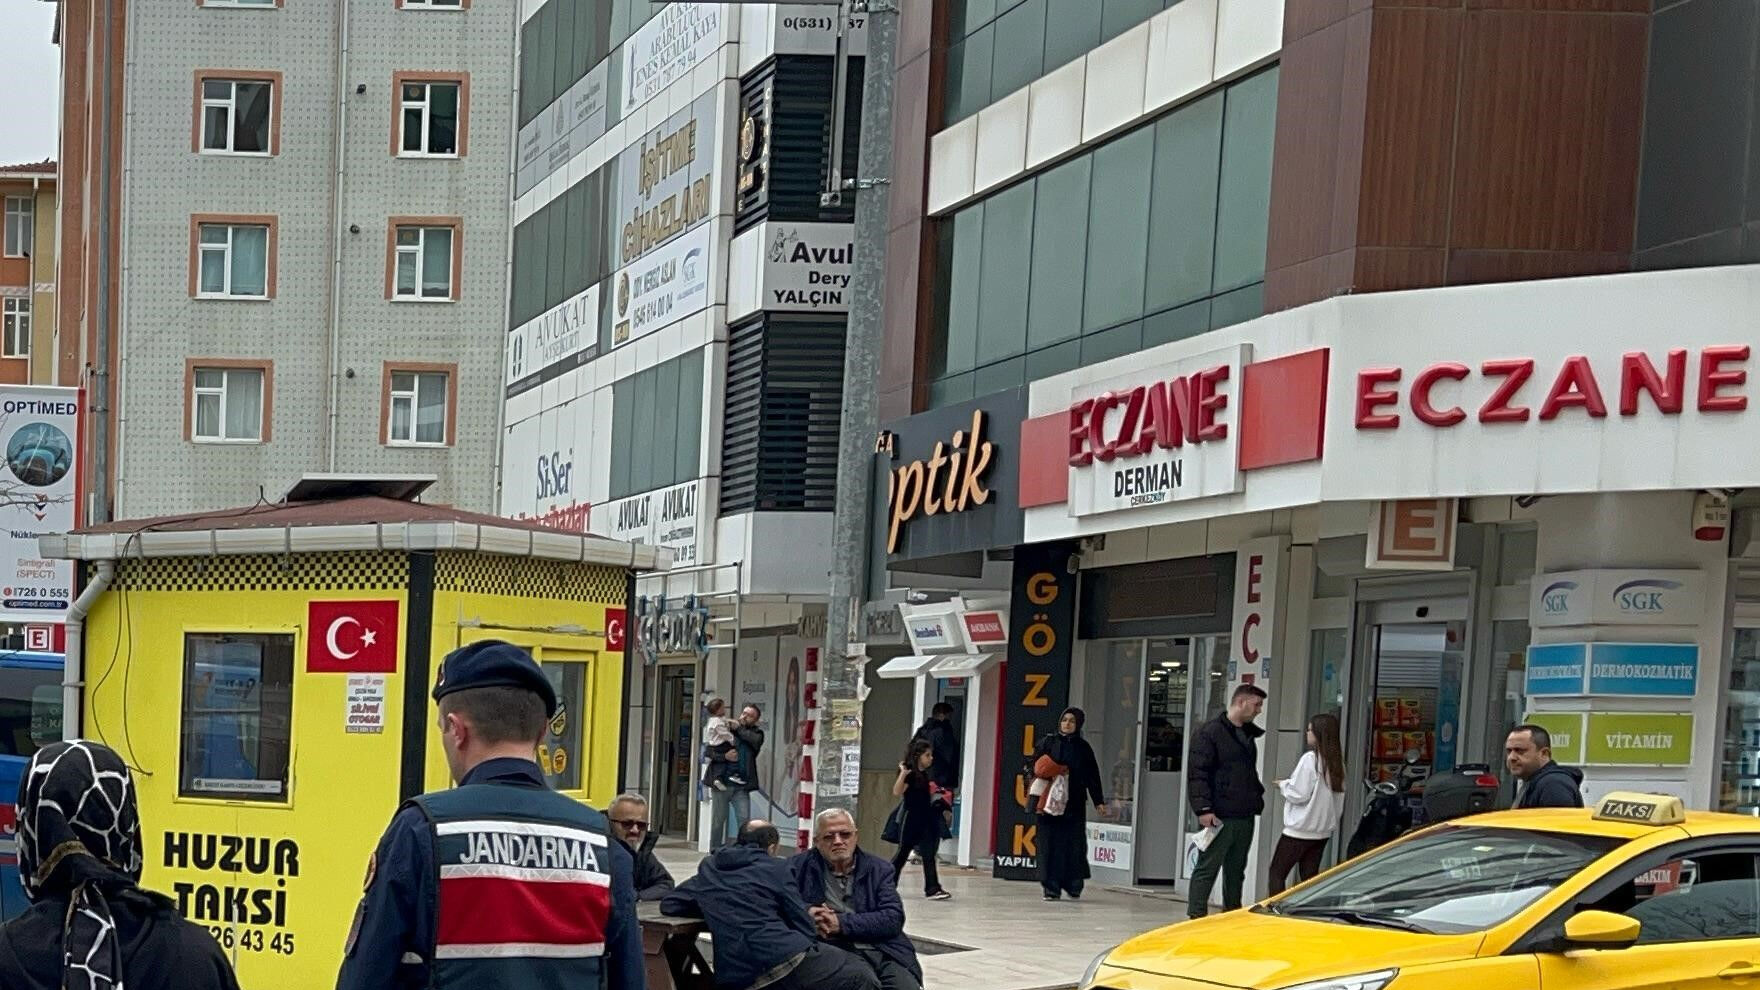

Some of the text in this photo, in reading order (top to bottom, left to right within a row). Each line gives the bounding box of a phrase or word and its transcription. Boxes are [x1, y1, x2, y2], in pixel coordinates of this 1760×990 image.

[651, 6, 701, 56] ARABULUCU
[784, 17, 832, 31] 0(531)
[635, 11, 717, 88] ENES KEMAL KAYA
[638, 119, 697, 201] İŞİTME
[622, 172, 711, 263] CİHAZLARI
[774, 290, 842, 308] YALÇIN
[535, 294, 589, 349] AVUKAT
[1355, 345, 1750, 429] ECZANE
[4, 400, 77, 415] OPTİMED
[1069, 365, 1229, 467] ECZANE
[887, 409, 992, 555] ptik
[1114, 459, 1183, 498] DERMAN
[617, 496, 650, 532] AVUKAT
[662, 484, 696, 523] AVUKAT
[16, 569, 55, 579] (SPECT)
[49, 588, 69, 598] 555
[1545, 594, 1569, 612] SGK
[1620, 593, 1664, 611] SGK
[32, 631, 44, 646] E
[970, 624, 1001, 633] AKBANK
[1592, 662, 1694, 680] DERMOKOZMATİK
[1606, 732, 1673, 748] VİTAMİN
[164, 831, 299, 876] HUZUR
[459, 832, 600, 872] JANDARMA
[1094, 847, 1116, 863] LENS
[173, 878, 286, 927] TAKSİ
[207, 925, 295, 955] 26 43 45
